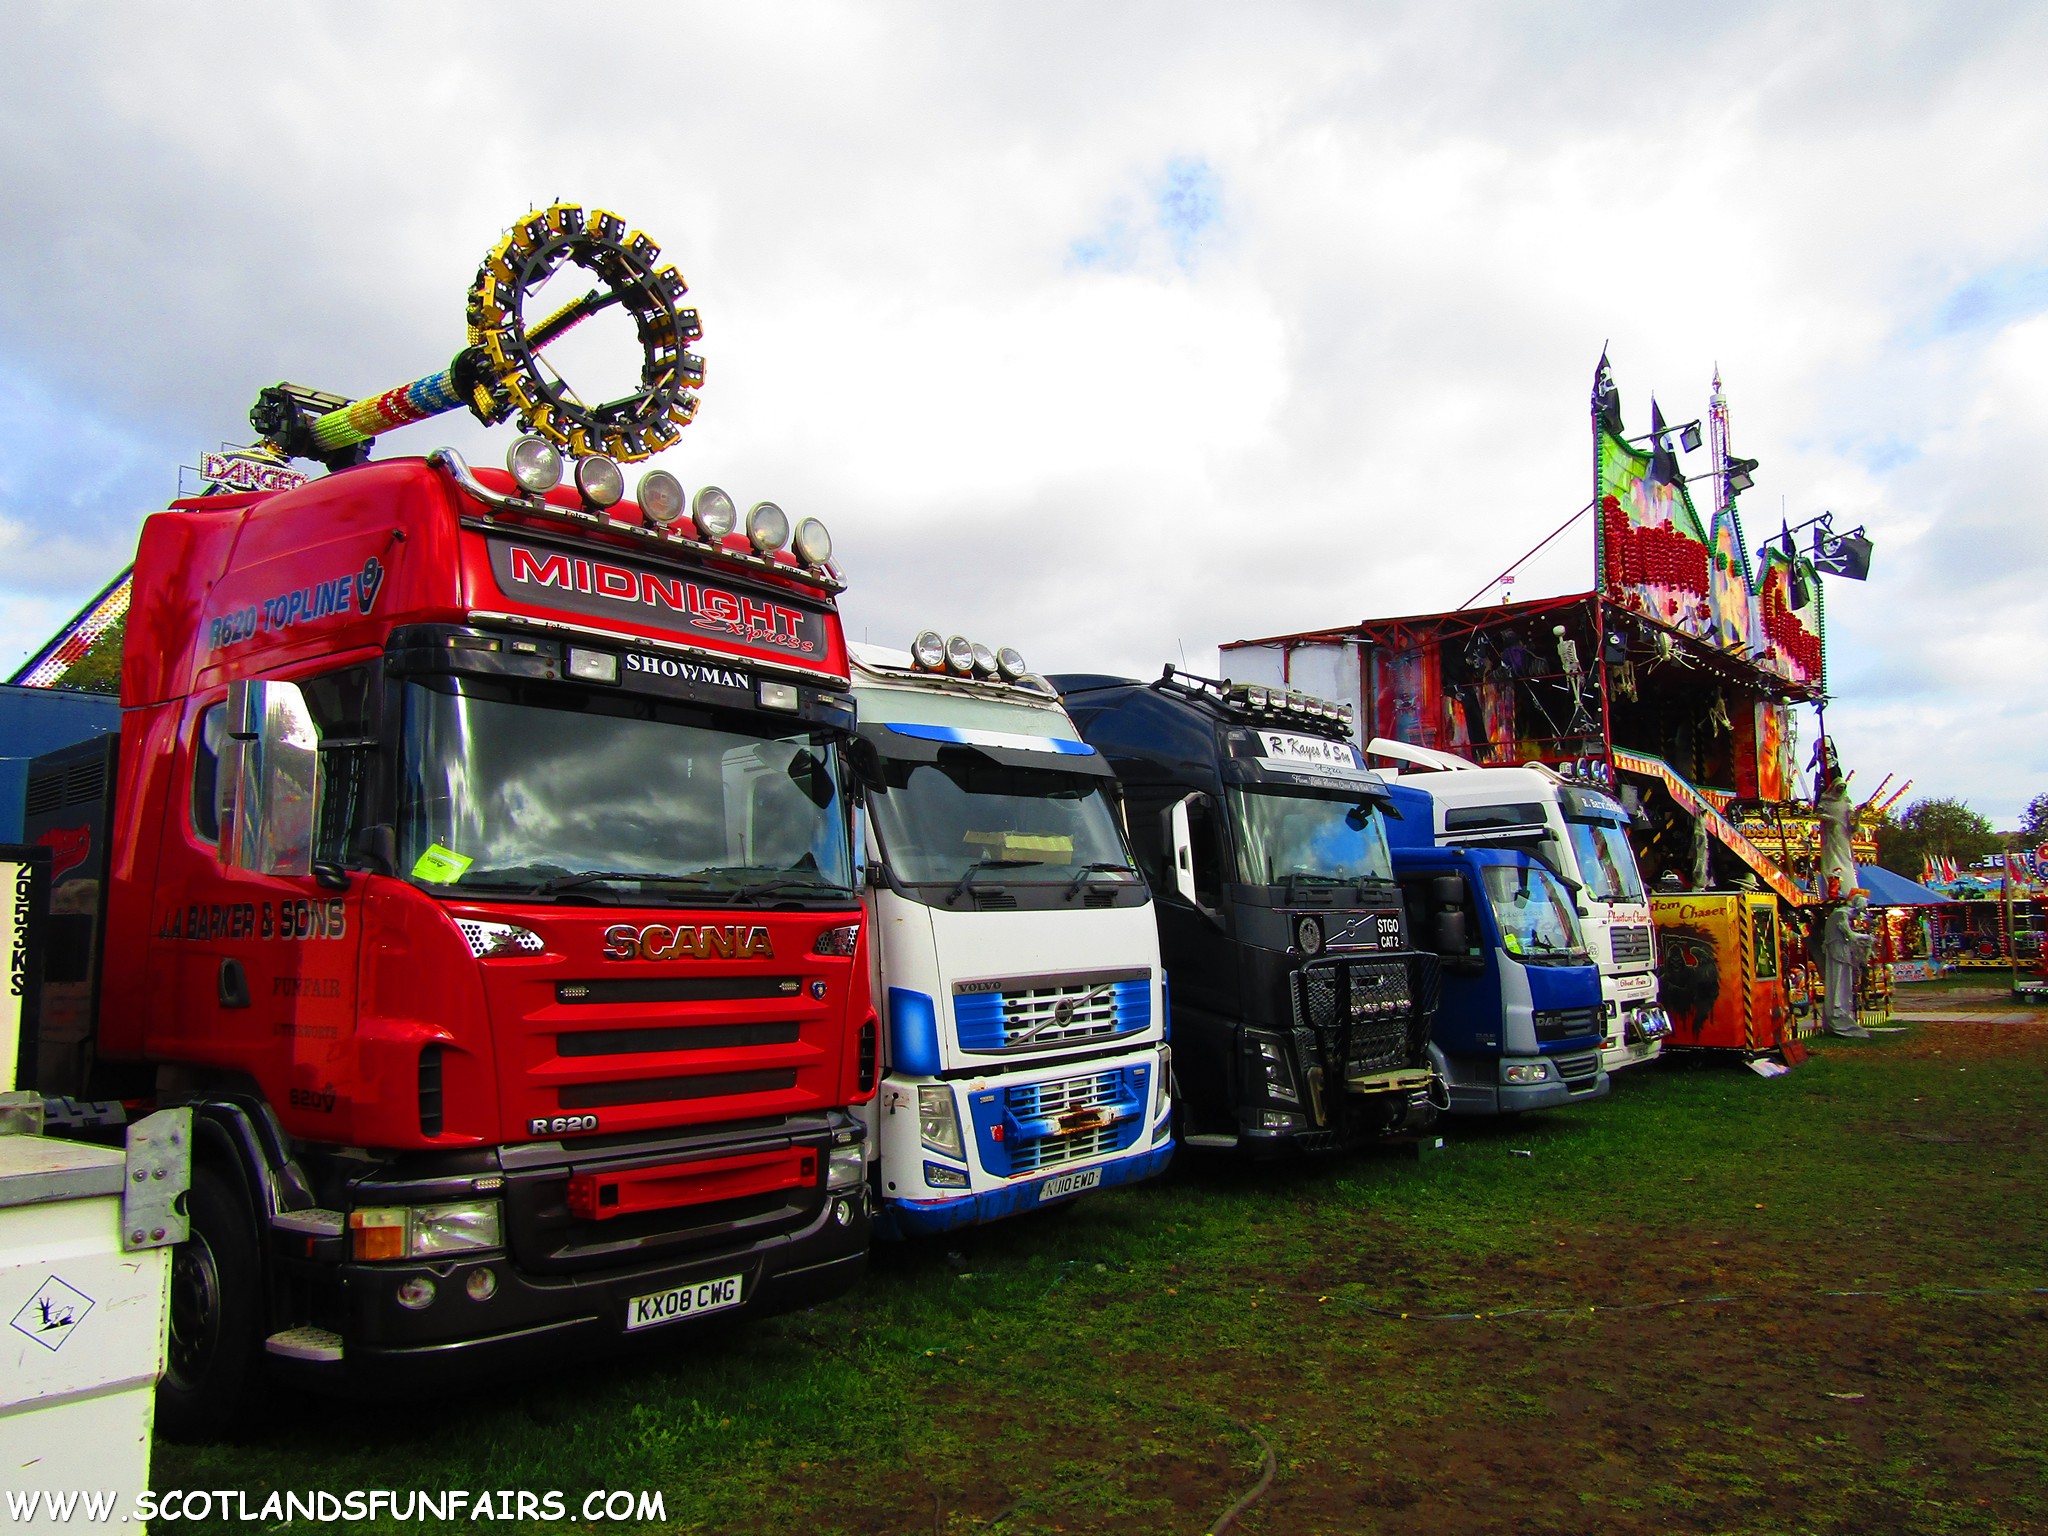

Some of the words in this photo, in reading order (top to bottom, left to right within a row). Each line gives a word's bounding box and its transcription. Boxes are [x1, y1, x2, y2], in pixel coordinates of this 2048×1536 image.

[509, 545, 804, 638] MIDNIGHT
[208, 605, 258, 651] R620
[264, 574, 353, 633] TOPLINE
[690, 608, 814, 652] Express
[625, 653, 750, 690] SHOWMAN
[1323, 742, 1332, 758] &
[187, 901, 255, 941] BARKER
[261, 901, 274, 941] &
[280, 897, 346, 941] SONS
[1377, 918, 1399, 933] STGO
[1680, 904, 1727, 920] Chaser
[603, 924, 775, 962] SCANIA
[1381, 936, 1394, 948] CAT
[1394, 936, 1400, 947] 2
[958, 981, 1002, 993] VOLVO
[1536, 1016, 1562, 1027] DAF
[532, 1118, 548, 1135] R
[552, 1115, 597, 1133] 620
[637, 1288, 692, 1322] KX08
[697, 1279, 735, 1308] CWG
